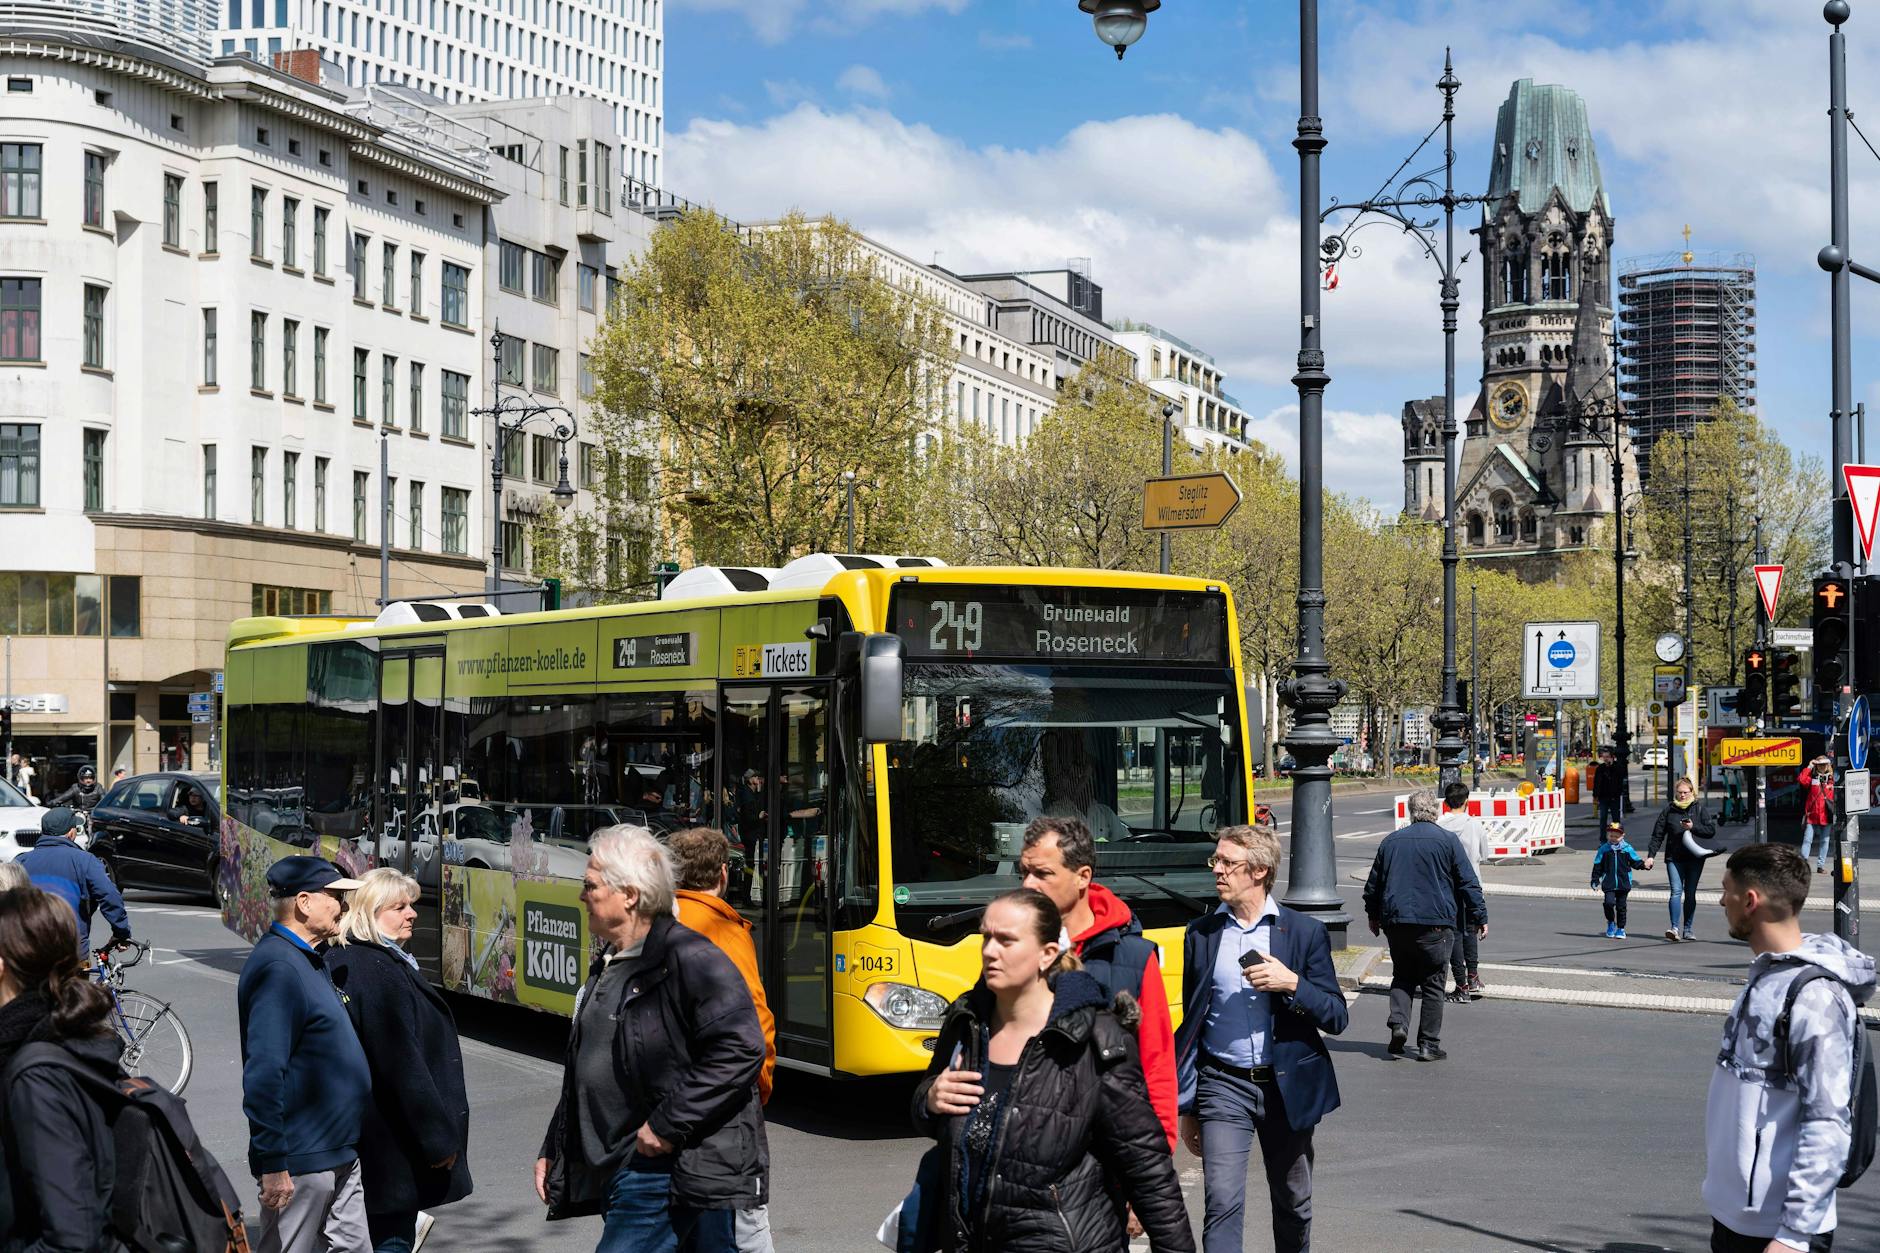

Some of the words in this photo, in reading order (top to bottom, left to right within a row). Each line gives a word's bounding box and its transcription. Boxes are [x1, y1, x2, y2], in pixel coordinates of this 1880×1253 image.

[1179, 484, 1208, 503] Steglitz
[1158, 504, 1206, 521] Wilmersdorf
[1043, 603, 1130, 623] Grunewald
[929, 600, 983, 651] 249
[619, 638, 637, 667] 249
[1035, 630, 1139, 654] Roseneck
[457, 647, 586, 679] www.pflanzen-koelle.de
[650, 647, 686, 665] Roseneck
[765, 646, 807, 673] Tickets
[1728, 746, 1796, 760] Umleitung
[526, 910, 577, 940] Pflanzen
[526, 940, 577, 986] Kölle
[860, 956, 893, 972] 1043
